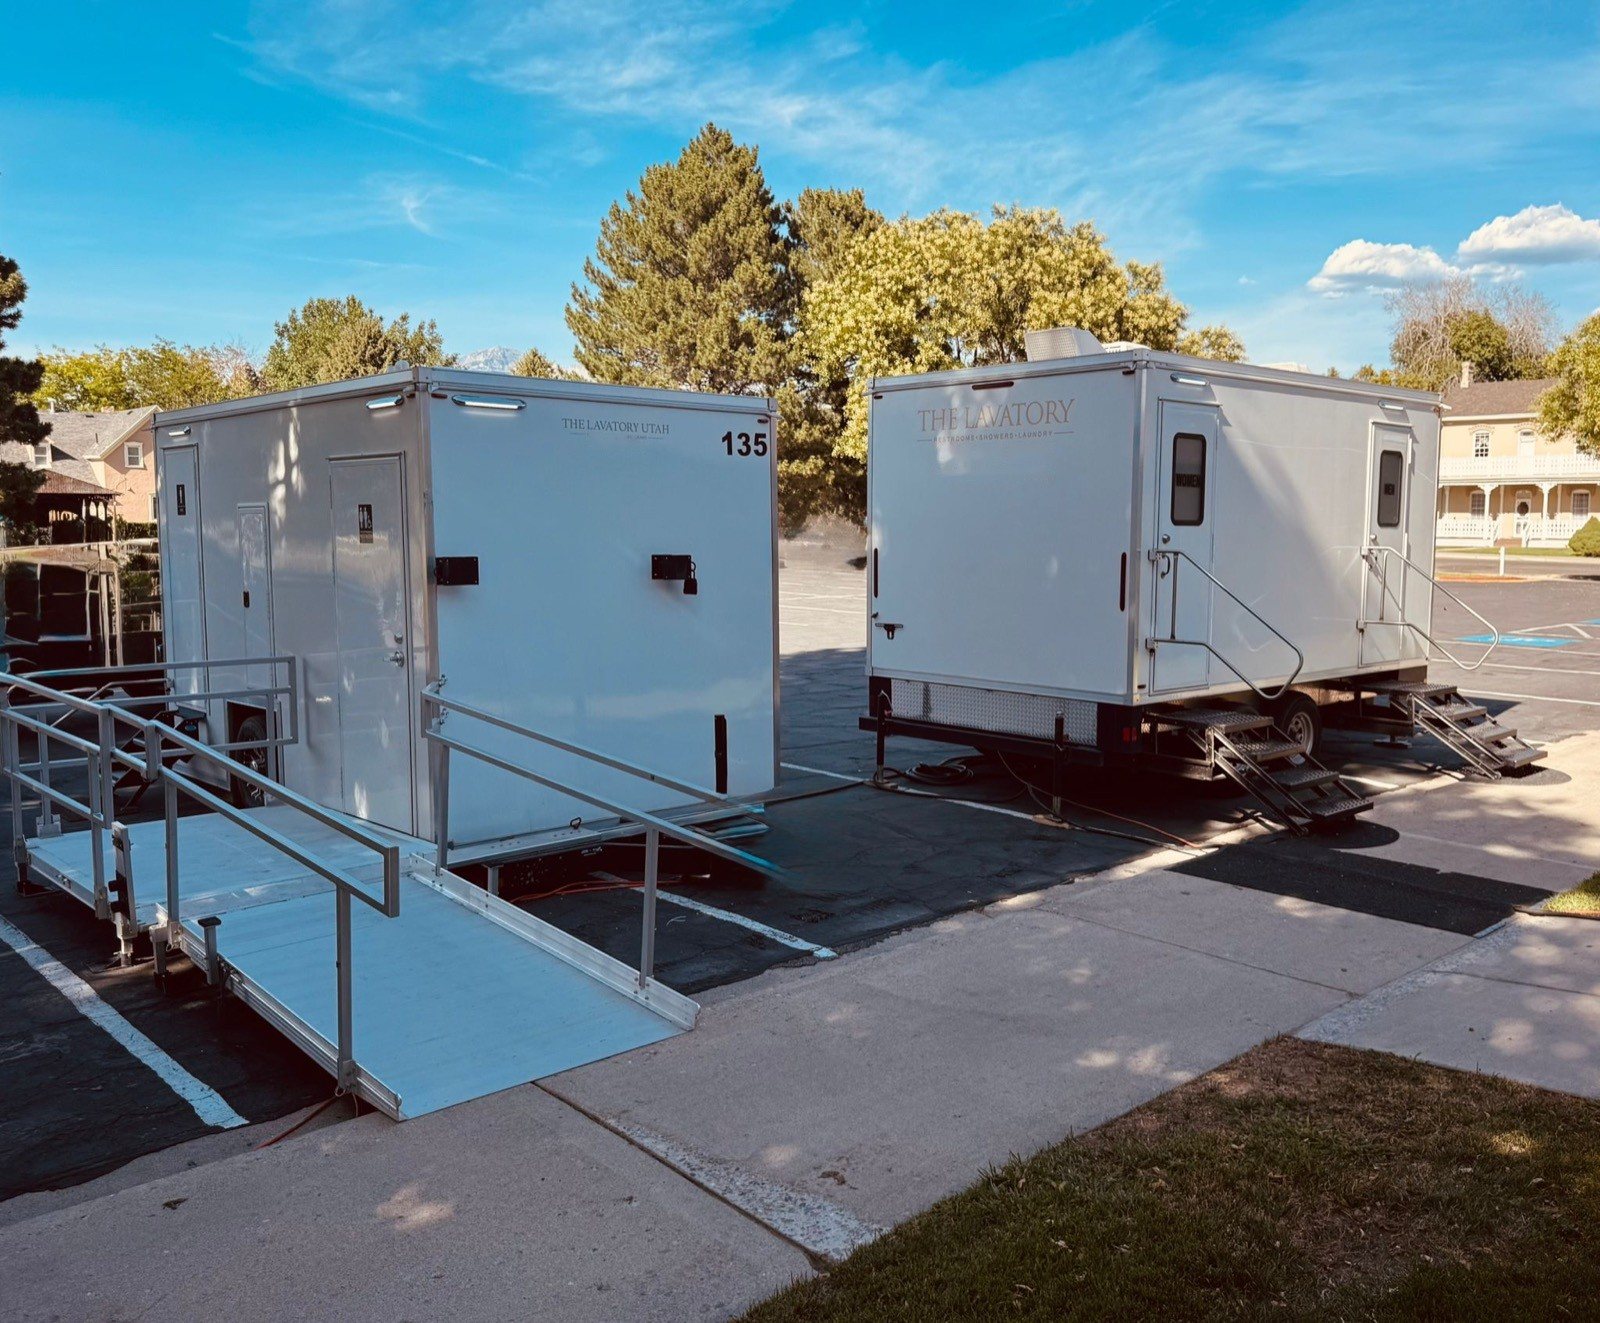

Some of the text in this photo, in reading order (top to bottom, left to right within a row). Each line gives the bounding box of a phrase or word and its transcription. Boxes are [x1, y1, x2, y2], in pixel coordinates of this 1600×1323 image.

[562, 418, 670, 435] THE LAVATORY UTAH
[917, 399, 1075, 432] THE LAVATORY
[722, 431, 767, 457] 135
